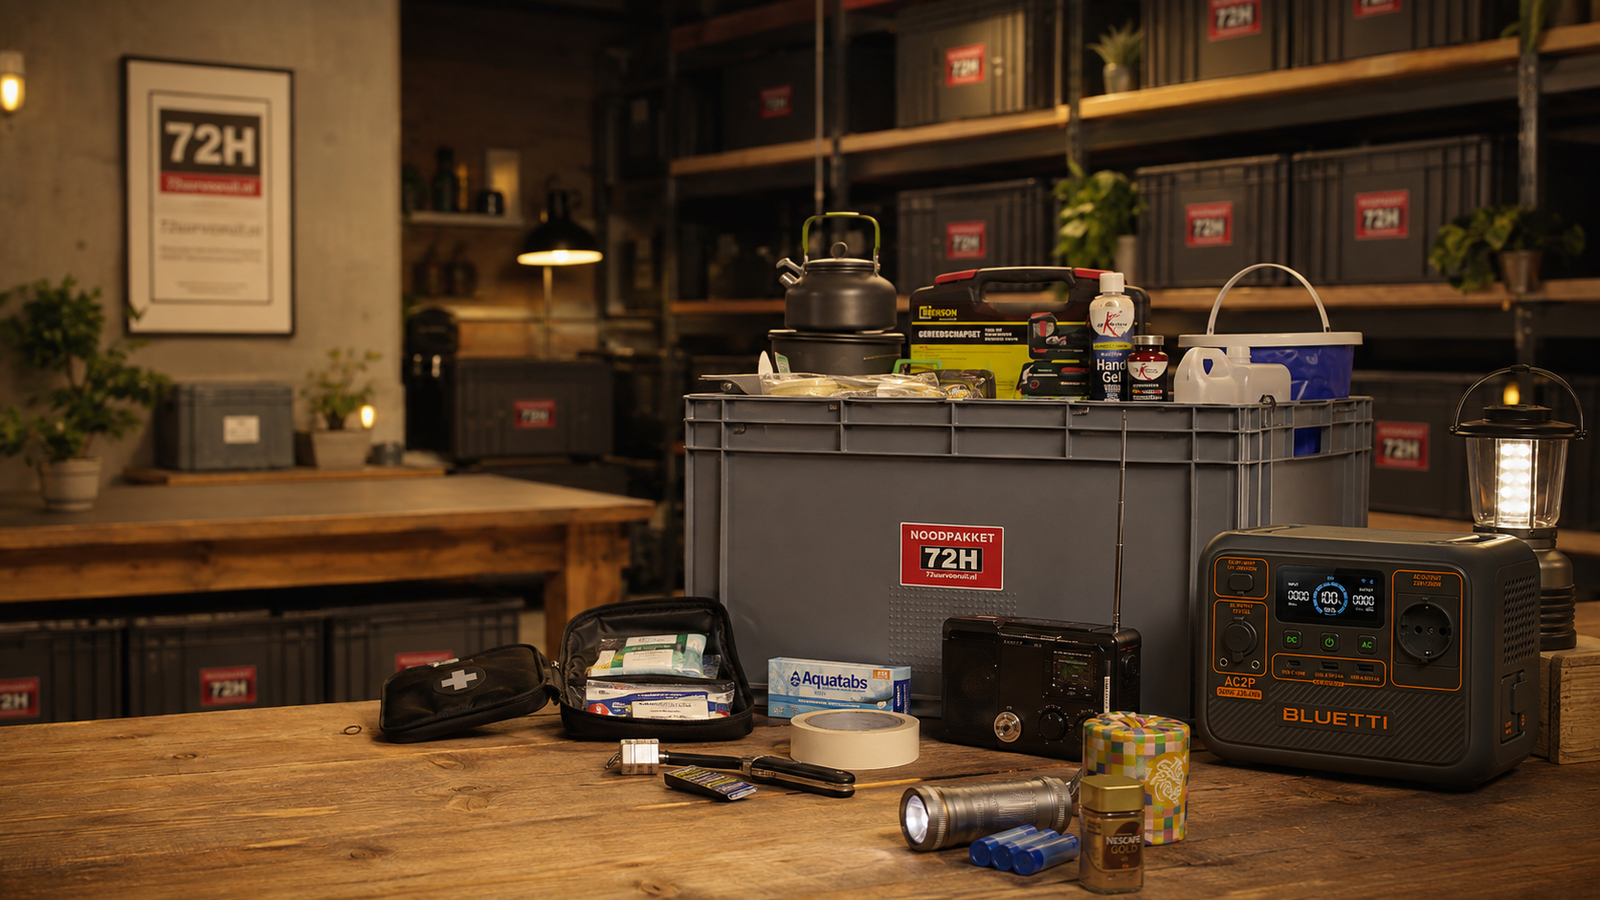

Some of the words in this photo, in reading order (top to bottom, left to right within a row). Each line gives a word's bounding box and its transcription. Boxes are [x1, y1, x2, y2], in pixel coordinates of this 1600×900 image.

[1215, 4, 1253, 29] 72H
[165, 121, 255, 167] 72H
[1193, 218, 1224, 237] 72H
[1363, 207, 1399, 229] 72H
[1097, 359, 1126, 371] Hand
[1102, 371, 1121, 383] Gel
[1383, 438, 1419, 459] 72H
[910, 530, 995, 543] NOODPAKKET
[924, 547, 978, 570] 72H
[1361, 641, 1373, 649] AC
[210, 679, 247, 698] 72H
[802, 671, 868, 690] Aquatabs
[1224, 675, 1256, 688] AC2P
[1283, 707, 1387, 730] BLUETTI
[1110, 844, 1138, 854] GOLD
